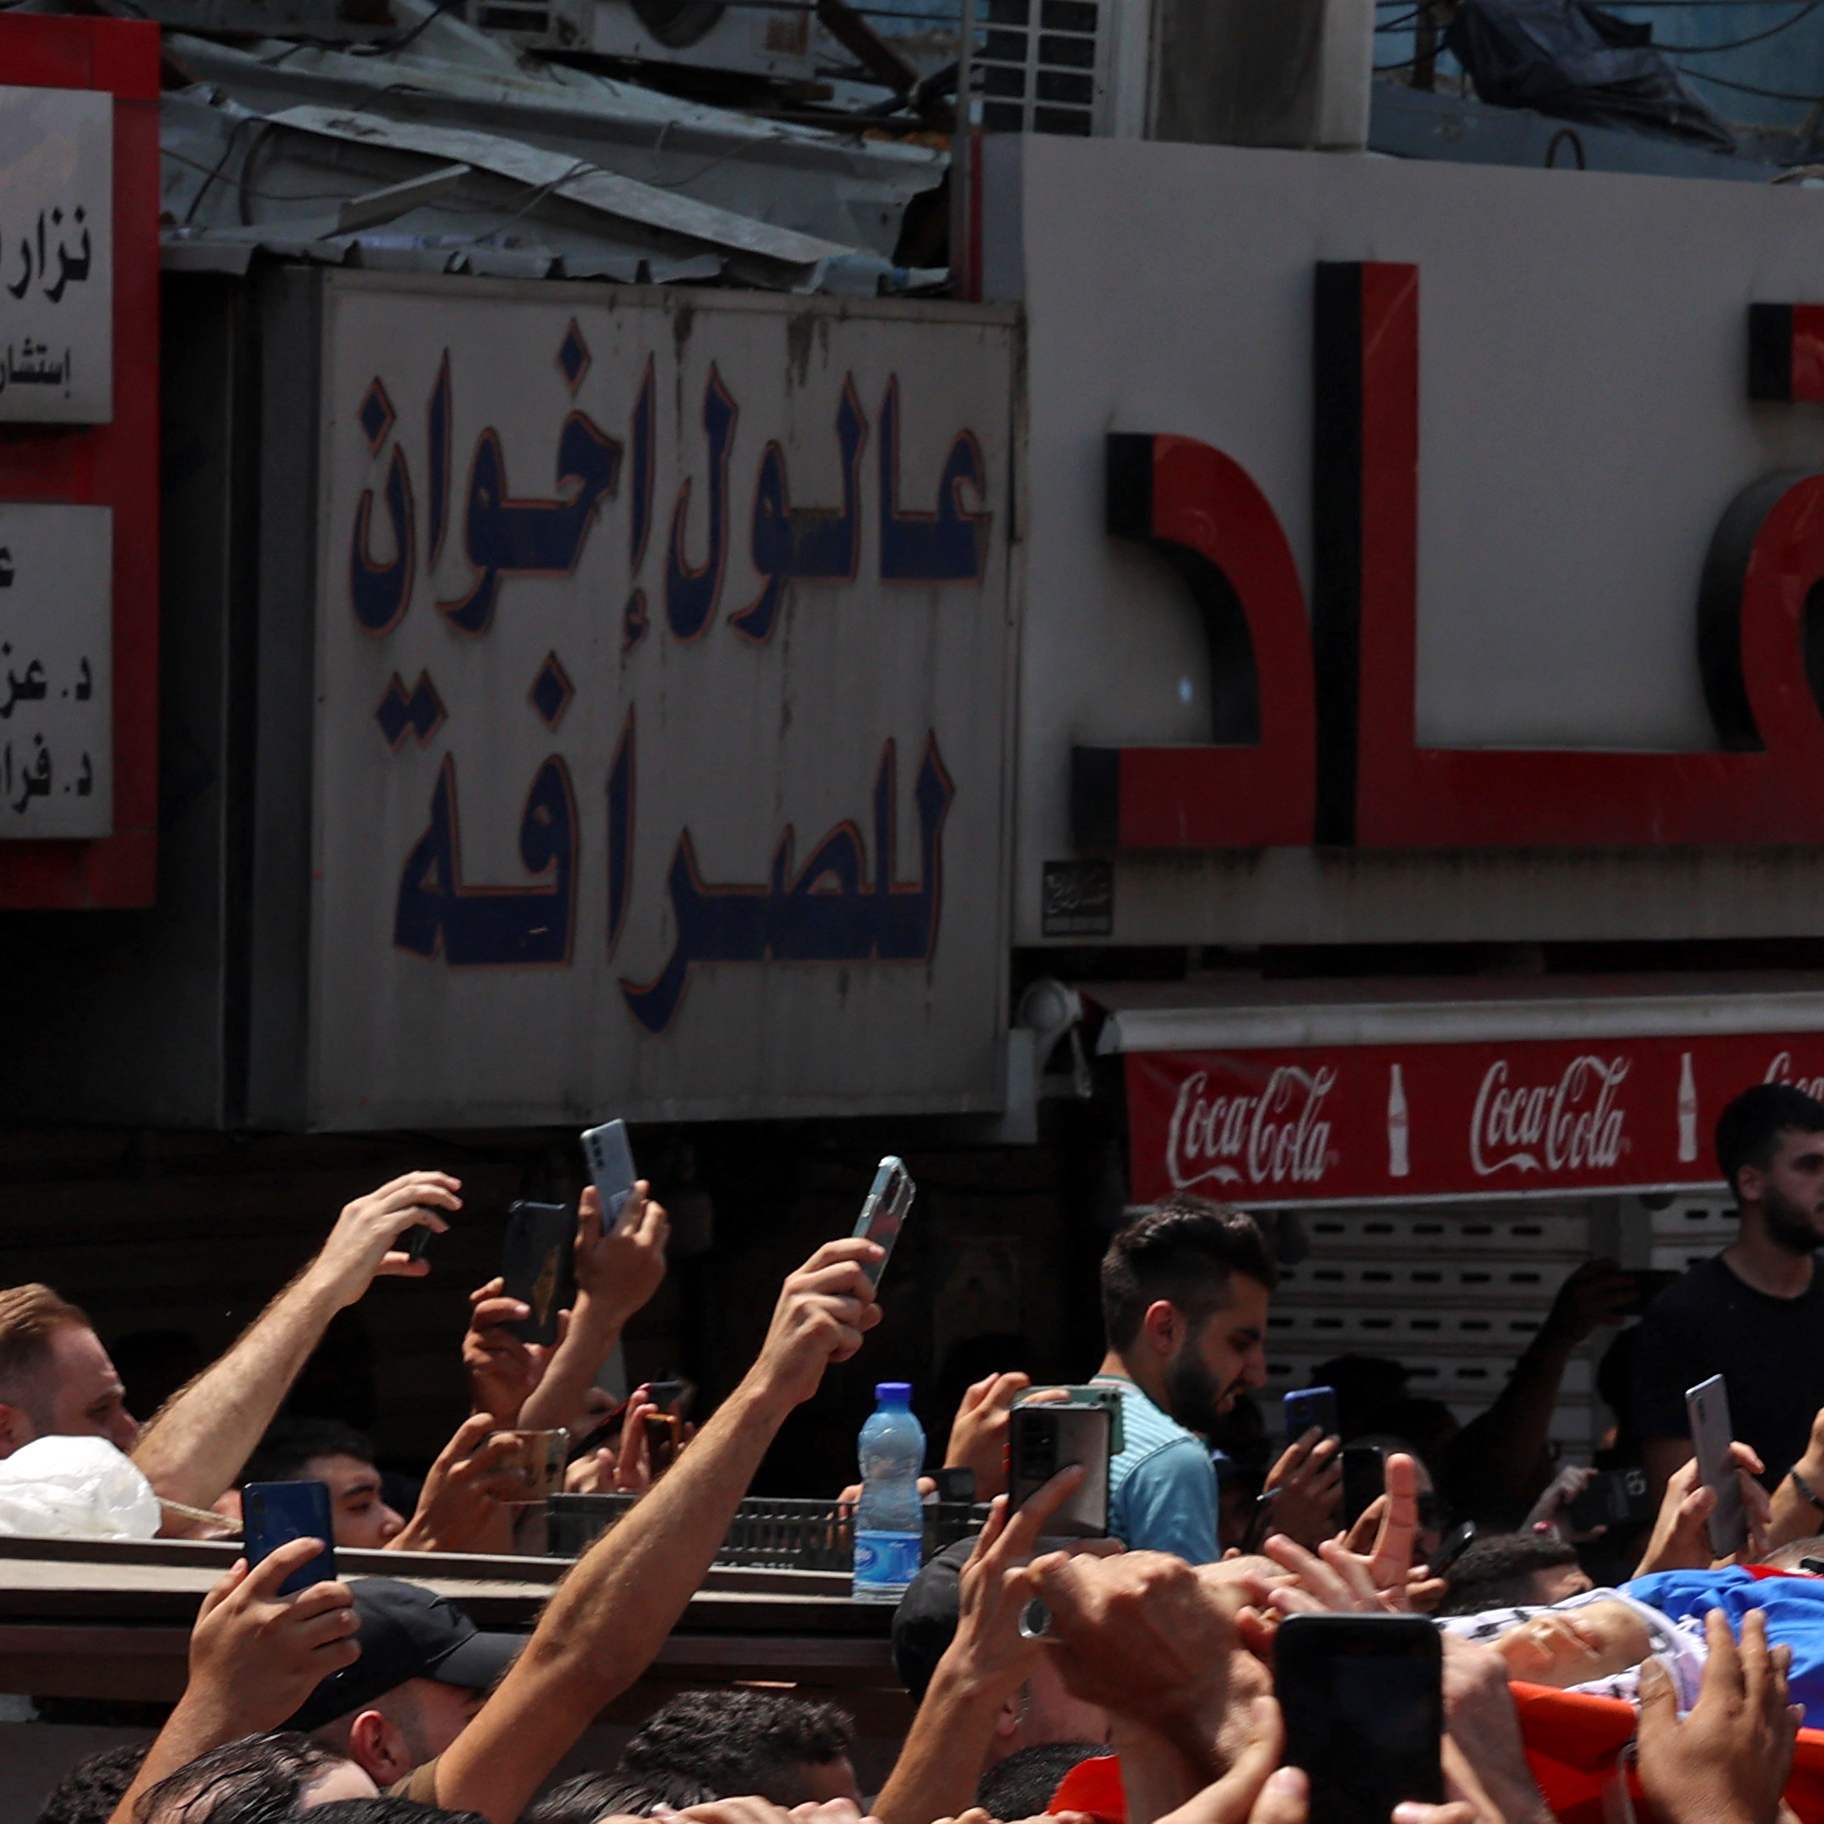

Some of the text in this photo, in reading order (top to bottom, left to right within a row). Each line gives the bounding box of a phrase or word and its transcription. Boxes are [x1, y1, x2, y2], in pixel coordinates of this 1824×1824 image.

[6, 204, 92, 303] نزار
[349, 318, 992, 652] عالول إخوان
[375, 649, 955, 1034] للصرافة
[1166, 1065, 1339, 1189] Coca-Cola
[1470, 1054, 1633, 1176] Coca-Cola
